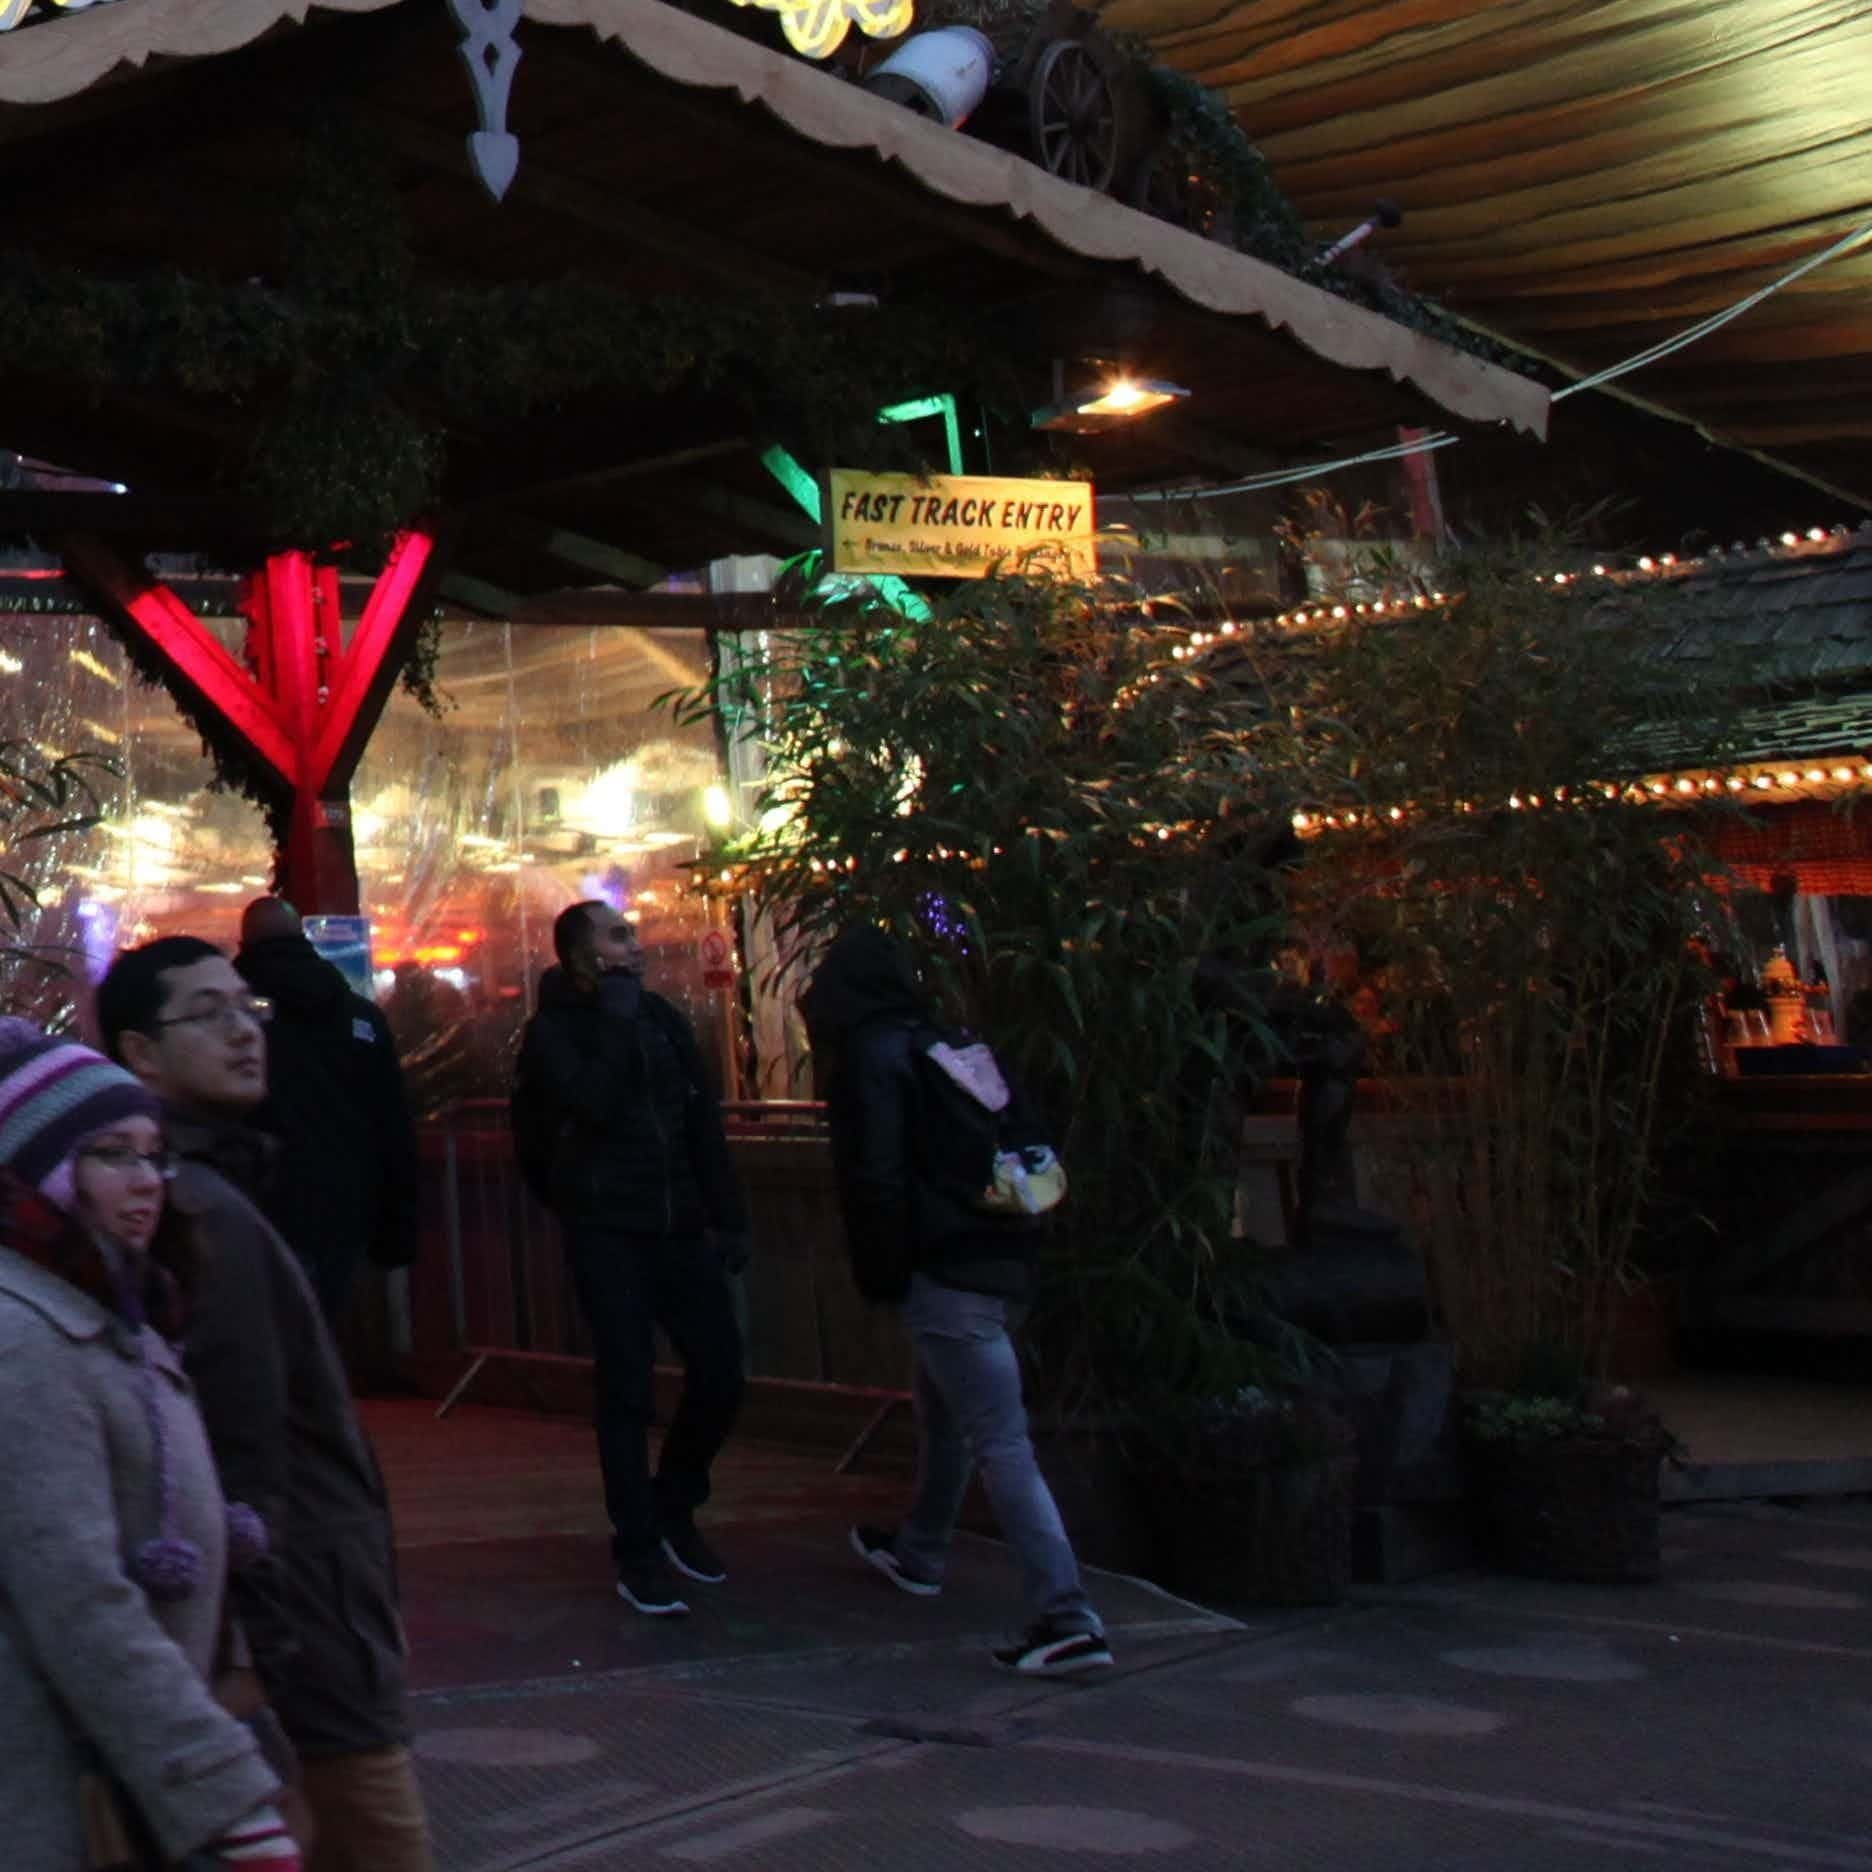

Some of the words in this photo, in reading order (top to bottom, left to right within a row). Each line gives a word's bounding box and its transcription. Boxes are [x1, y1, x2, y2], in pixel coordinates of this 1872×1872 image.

[841, 491, 904, 524] FAST
[910, 494, 996, 529] TRACK
[1001, 500, 1083, 533] ENTRY
